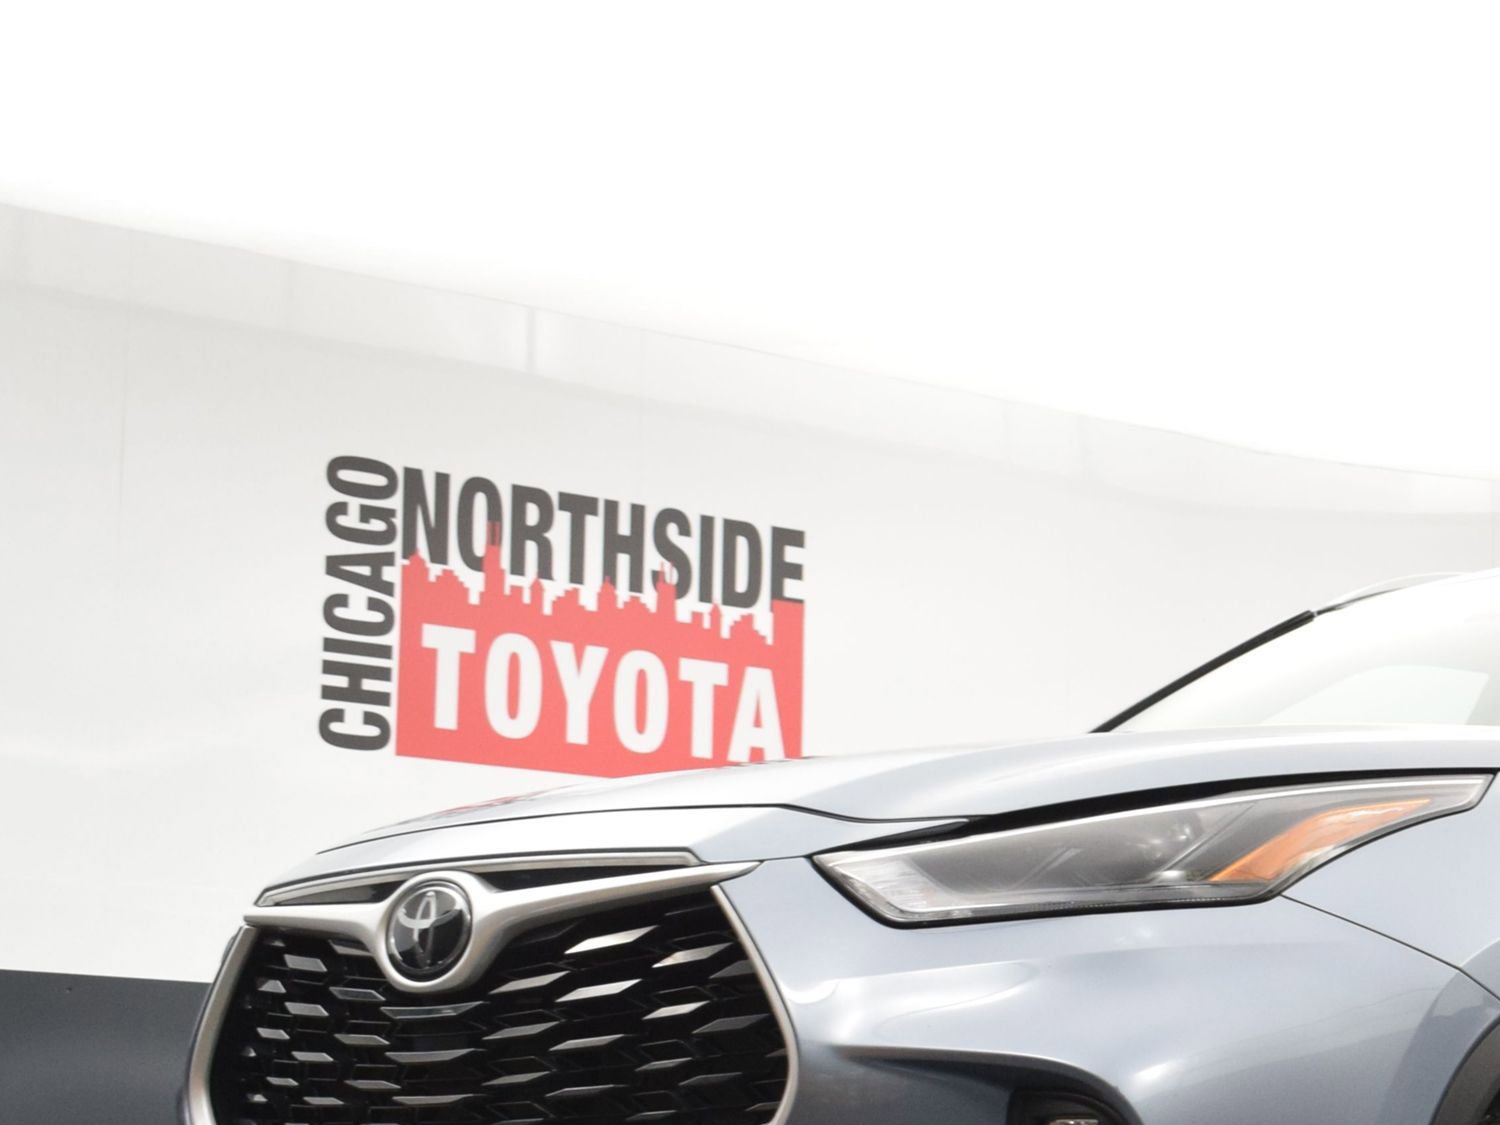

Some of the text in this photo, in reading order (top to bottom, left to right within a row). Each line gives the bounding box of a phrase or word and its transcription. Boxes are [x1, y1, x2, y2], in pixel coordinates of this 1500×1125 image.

[317, 455, 400, 752] CHICAGO
[402, 466, 806, 610] NORTHSIDE
[420, 623, 786, 764] TOYOTA
